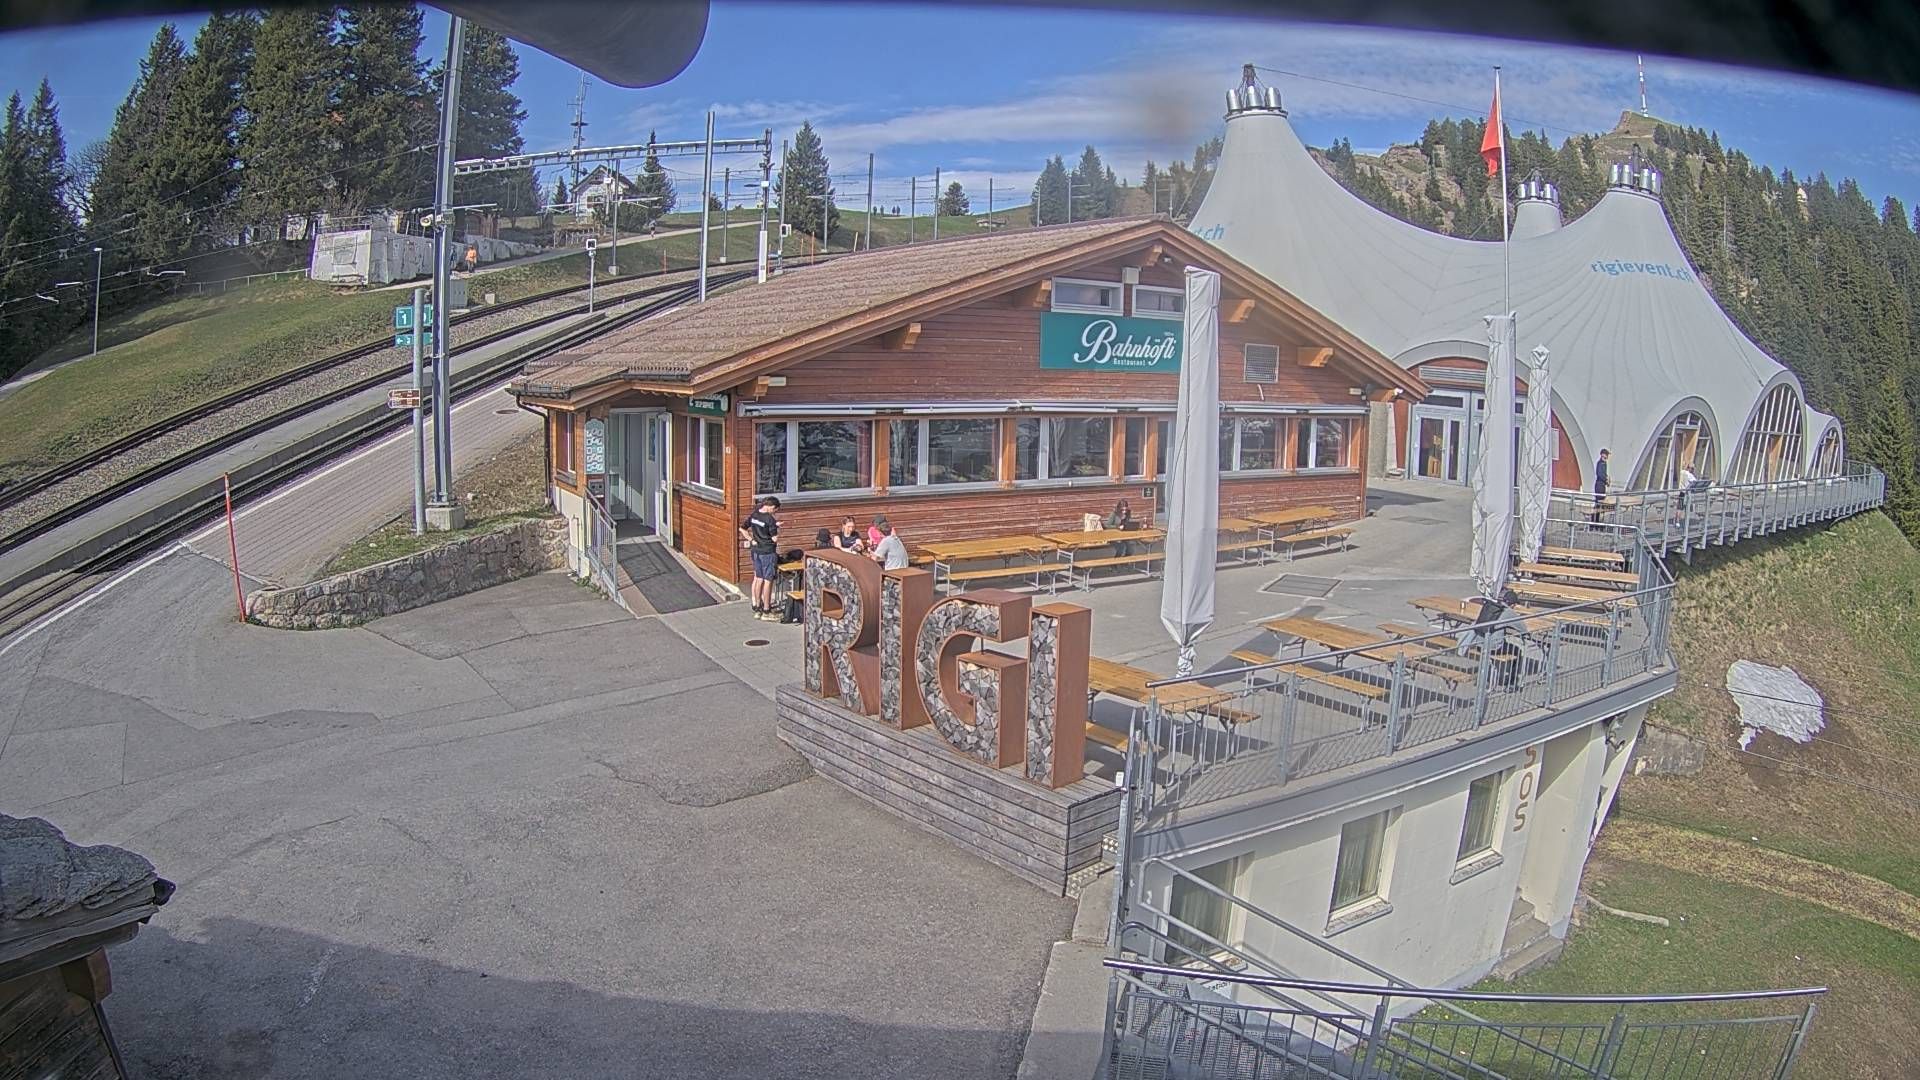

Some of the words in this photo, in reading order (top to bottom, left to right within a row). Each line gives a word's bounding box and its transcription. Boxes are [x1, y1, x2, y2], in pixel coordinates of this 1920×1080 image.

[1591, 259, 1694, 283] rigievent.ch
[1073, 319, 1177, 366] Bahnhöfli
[804, 549, 1091, 789] RIGI
